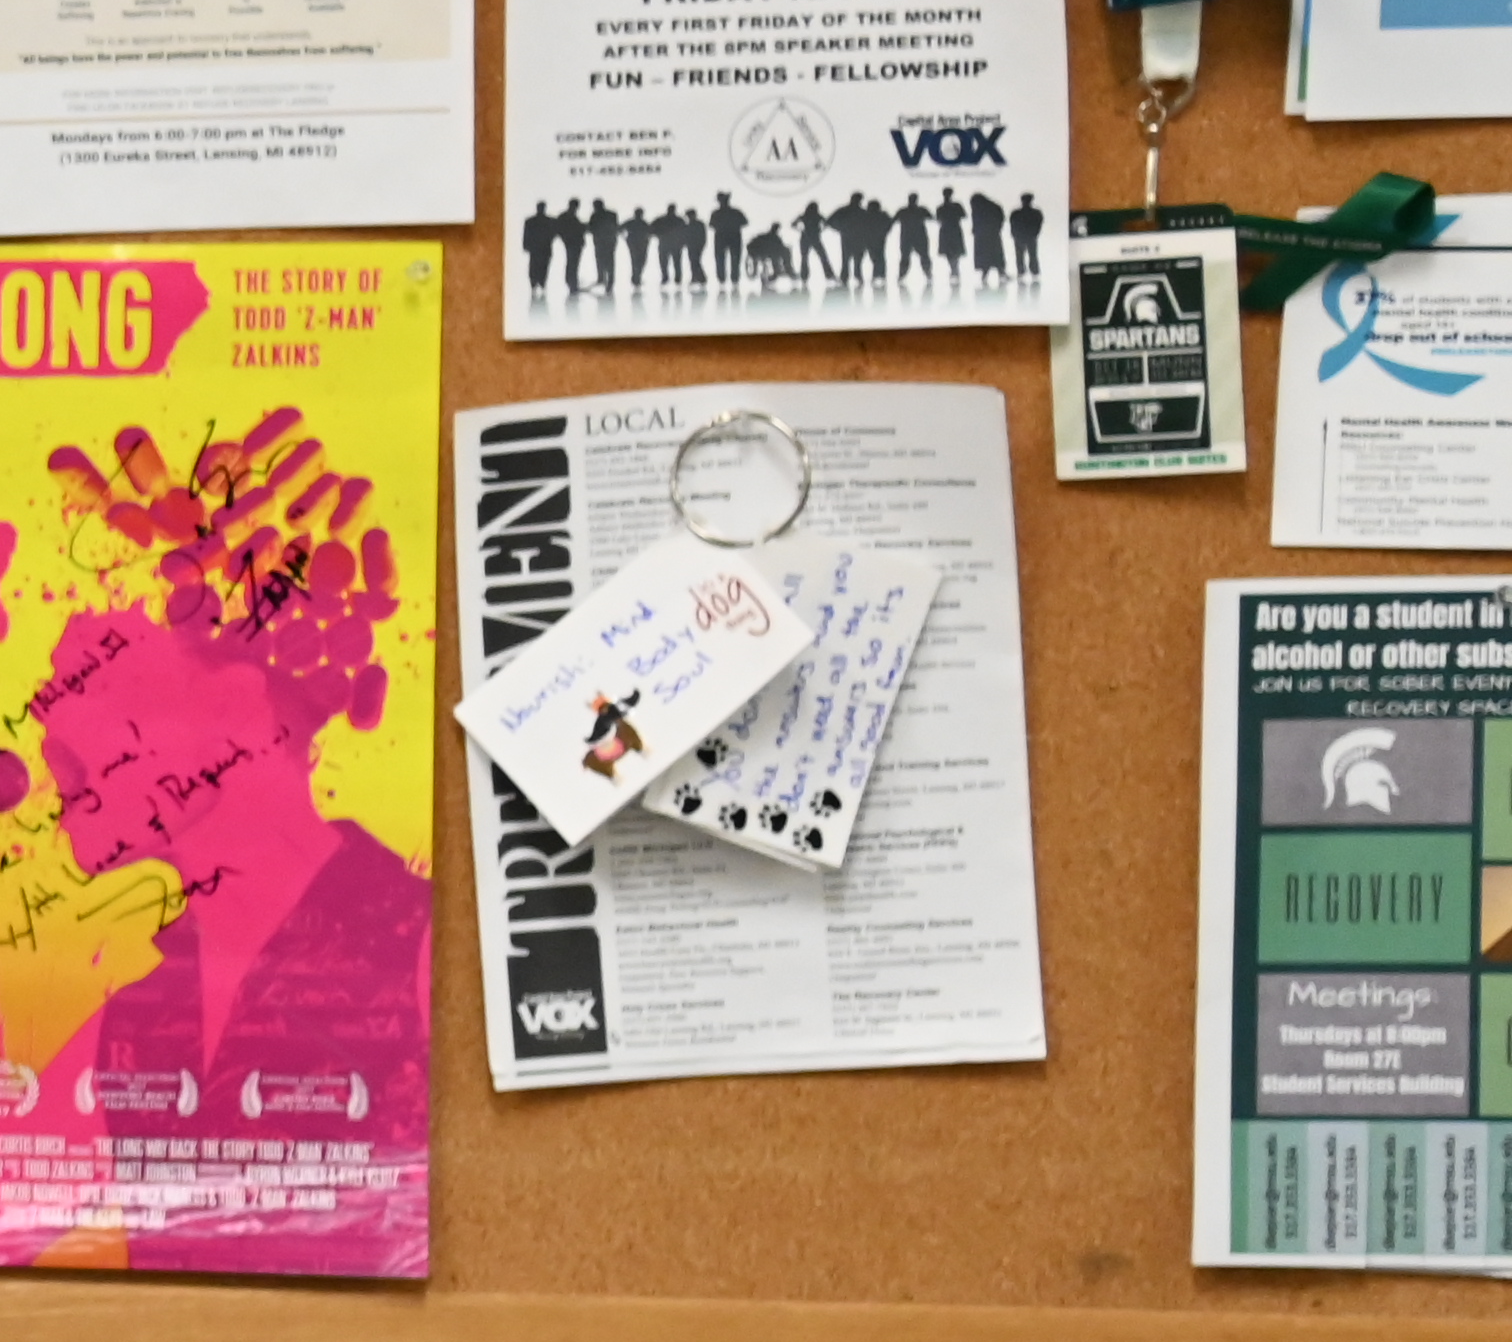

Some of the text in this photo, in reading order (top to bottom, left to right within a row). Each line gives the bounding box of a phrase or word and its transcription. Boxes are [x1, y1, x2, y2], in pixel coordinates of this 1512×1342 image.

[596, 8, 983, 36] EVERY FIRST FRIDAY OF THE MONTH
[603, 41, 669, 60] AFTER
[677, 40, 717, 57] THE
[774, 36, 871, 55] SPEAKER
[878, 33, 975, 51] MEETING
[589, 59, 990, 91] FUN FRIENDS FELLOWSHIP
[50, 130, 115, 145] Mondays
[117, 129, 151, 143] from
[225, 129, 247, 142] pm
[250, 127, 265, 140] at
[268, 125, 293, 138] The
[889, 125, 1008, 169] VOX
[102, 149, 151, 164] Eureka
[265, 145, 284, 158] MI
[233, 268, 384, 294] THE STORY OF
[232, 304, 384, 331] TODD 'Z-MAN'
[1088, 322, 1201, 352] SPARTANS
[231, 342, 321, 368] ZALKINS
[584, 406, 685, 437] LOCAL
[688, 573, 772, 637] dog
[1255, 599, 1505, 635] Are you a student in
[600, 600, 656, 649] Mind
[627, 625, 697, 677] Body
[1252, 640, 1344, 671] alcohol
[1348, 645, 1377, 670] or
[1381, 639, 1451, 669] other
[652, 654, 713, 707] Soul
[1253, 675, 1294, 694] JOIN
[1329, 675, 1372, 692] FOR
[1378, 674, 1446, 692] SOBER
[1346, 698, 1451, 718] RECOVERY
[1284, 871, 1444, 924] RECOVERY
[516, 996, 600, 1036] VOX
[1287, 979, 1434, 1023] Meetings
[1279, 1023, 1363, 1047] Thursdays
[1365, 1024, 1384, 1046] at
[1261, 1074, 1466, 1098] Student Services Building
